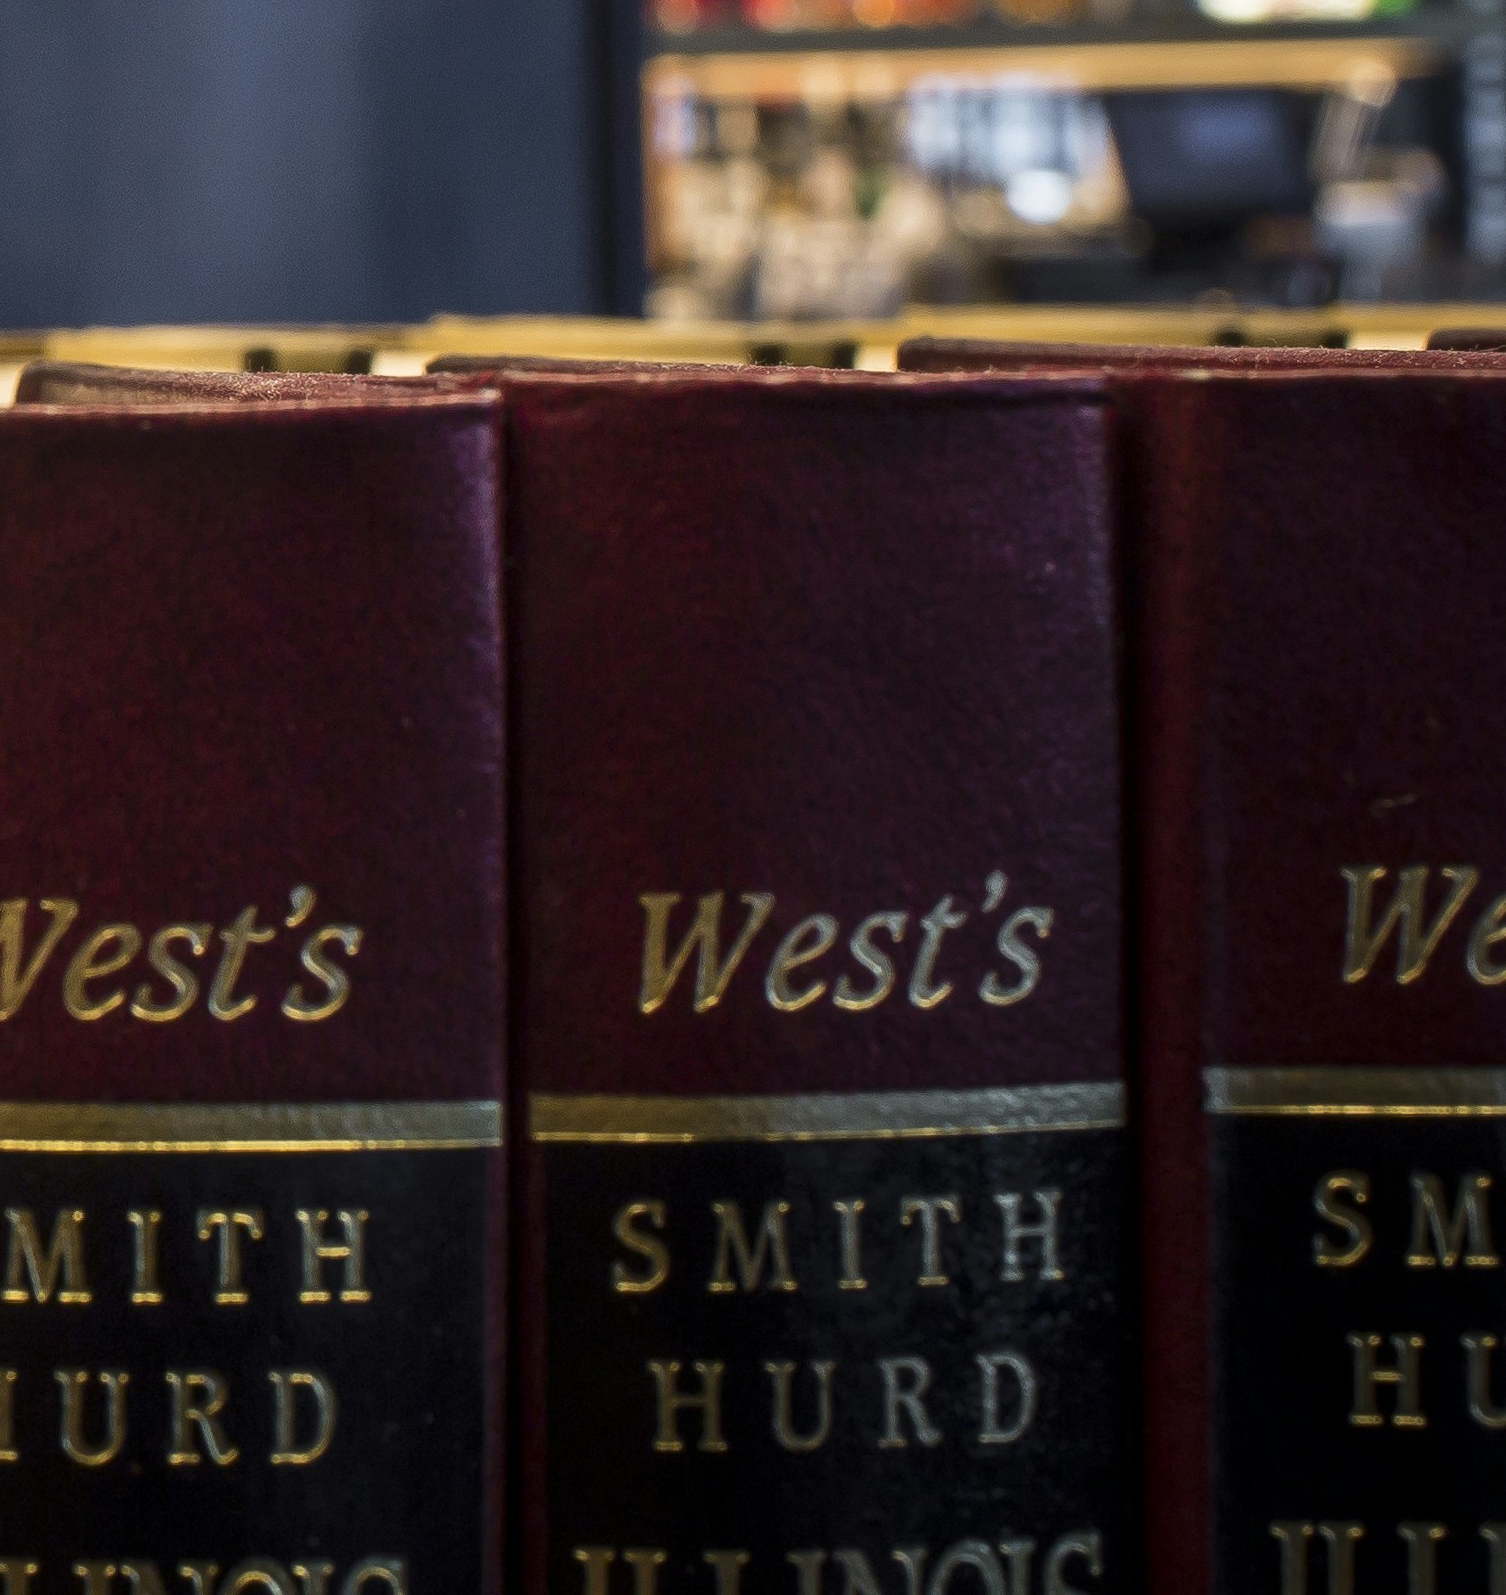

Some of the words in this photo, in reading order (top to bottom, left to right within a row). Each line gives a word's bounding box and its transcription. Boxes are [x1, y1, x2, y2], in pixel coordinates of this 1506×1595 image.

[636, 870, 1054, 1015] West's
[609, 1191, 1064, 1296] SMITH
[1310, 1170, 1502, 1268] SM
[646, 1350, 1040, 1454] HURD
